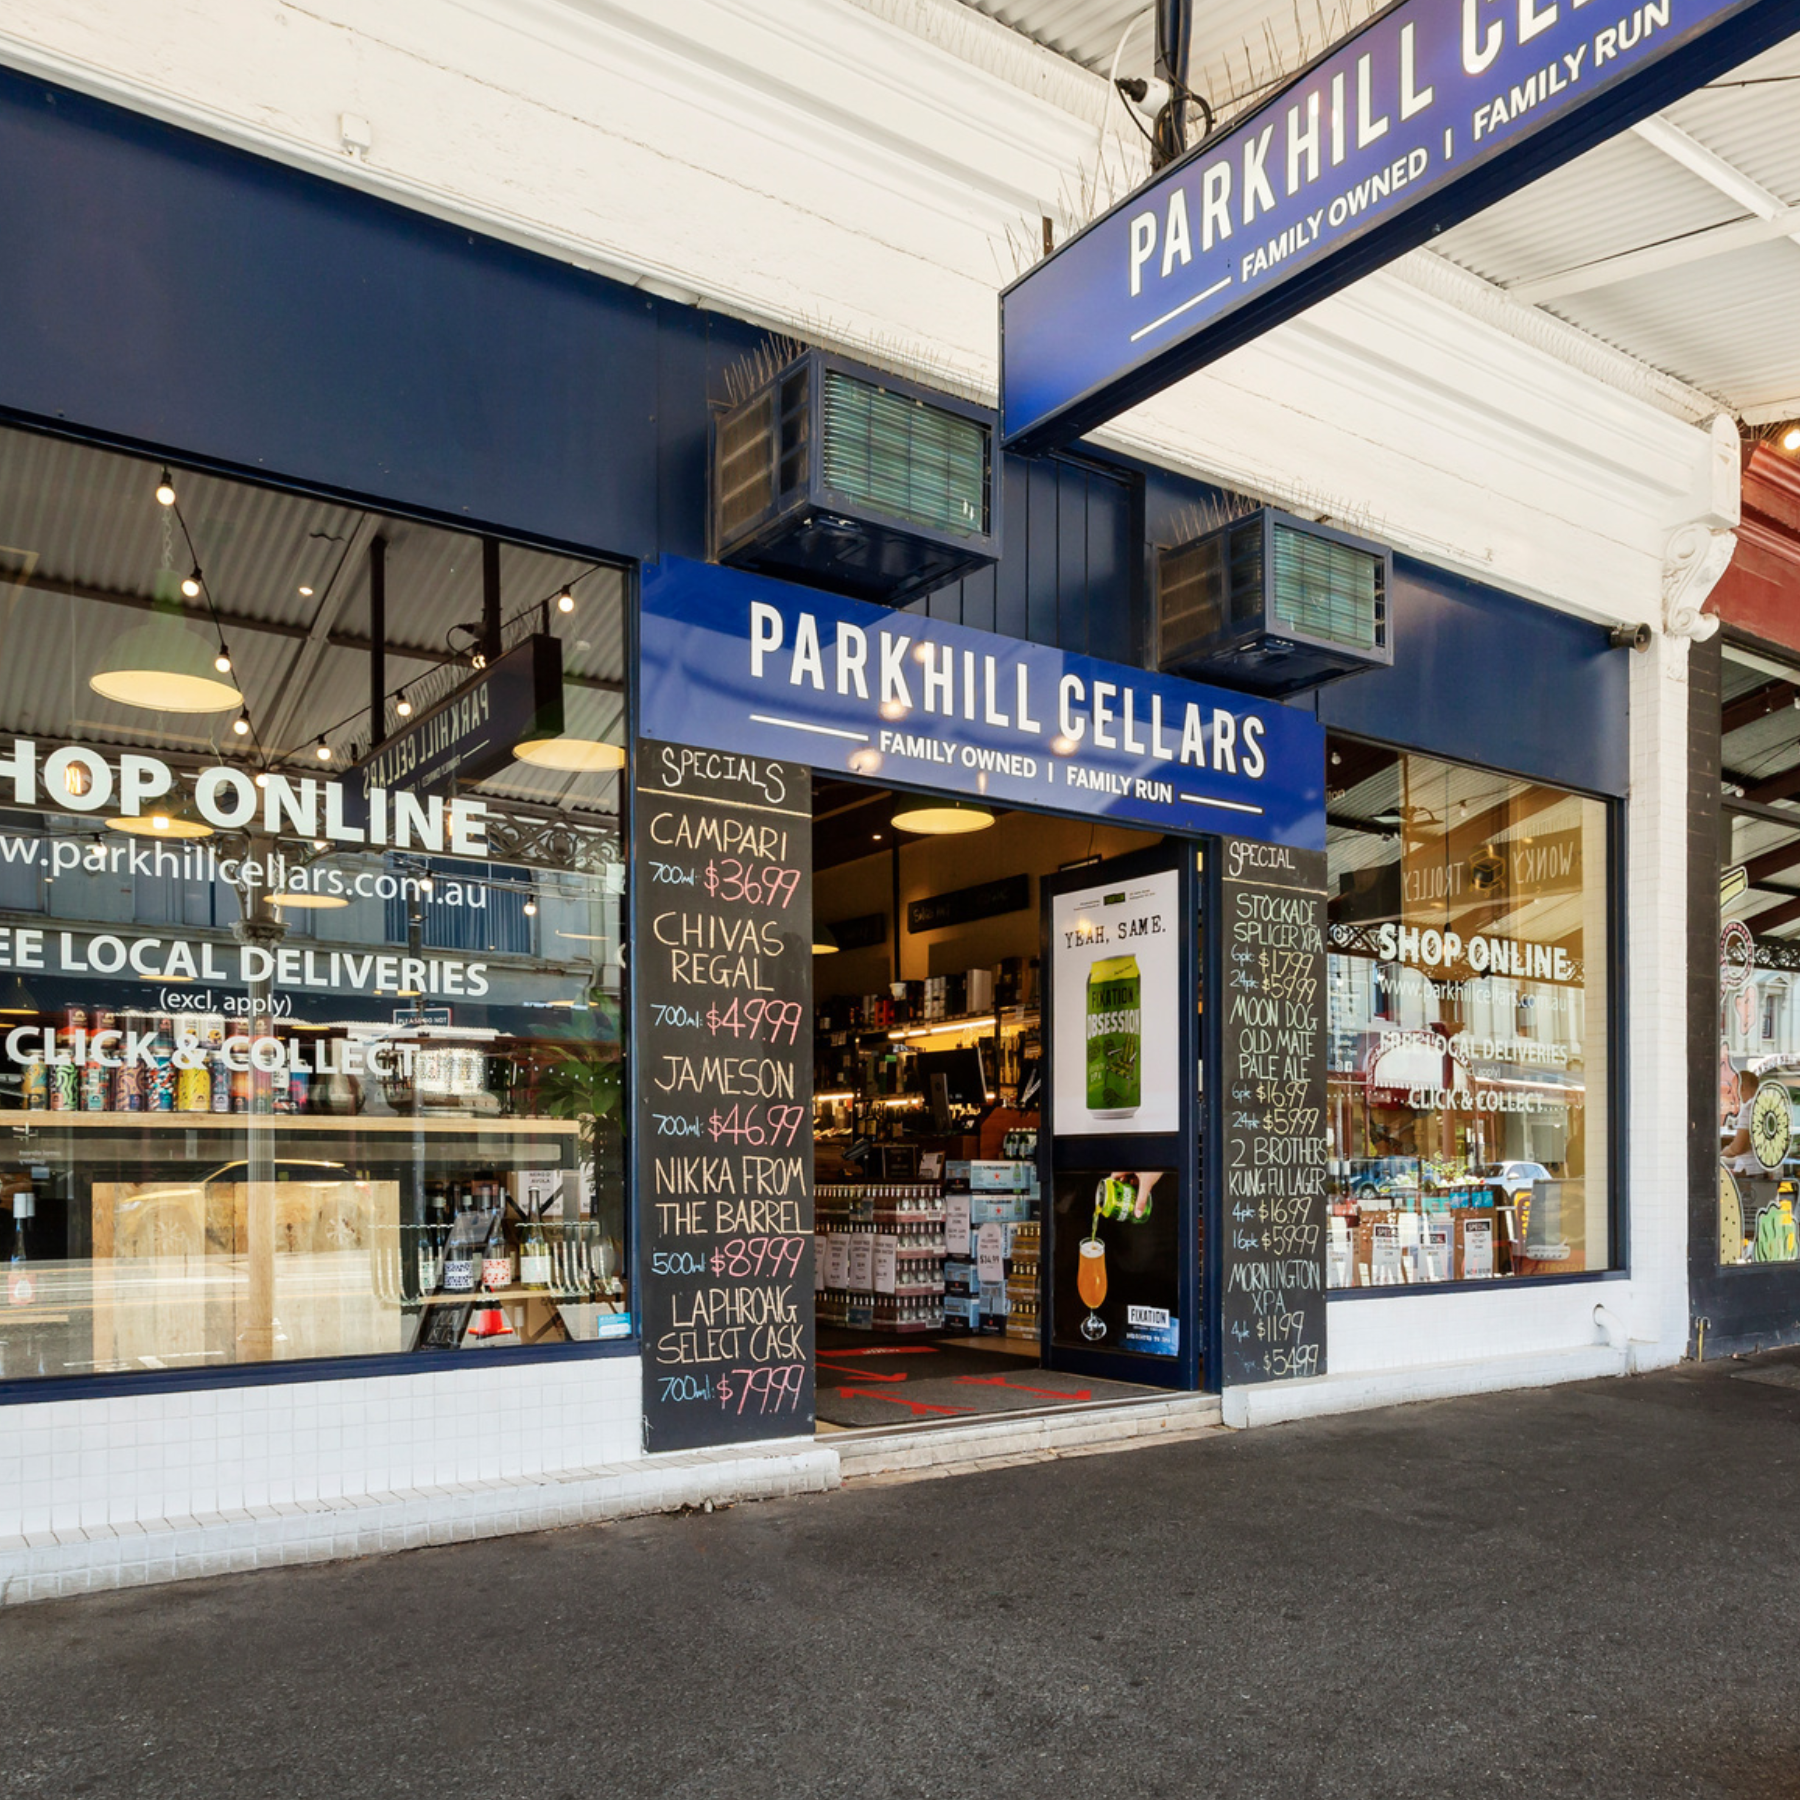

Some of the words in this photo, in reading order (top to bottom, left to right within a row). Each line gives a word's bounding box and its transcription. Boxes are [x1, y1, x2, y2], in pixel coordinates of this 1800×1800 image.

[1129, 18, 1434, 297] PARKHILL
[1240, 208, 1325, 283] FAMILY
[1329, 147, 1428, 228] OWNED
[1473, 44, 1587, 141] FAMILY
[1595, 0, 1669, 67] RUN
[749, 600, 1041, 735] PARKHILL
[1058, 674, 1266, 780] CELLARS
[661, 746, 786, 804] SPECIALS
[879, 730, 957, 762] FAMILY
[961, 746, 1037, 779] OWNED
[1066, 766, 1132, 795] FAMILY
[1133, 779, 1173, 804] RUN
[196, 767, 488, 857] ONLINE
[650, 812, 788, 862] CAMPARI
[1228, 840, 1296, 877] SPECIAL
[703, 858, 802, 910] $36.99
[1236, 892, 1318, 929] STOCKADE
[653, 910, 785, 957] CHIVAS
[1064, 925, 1110, 949] YEAH,
[1117, 914, 1166, 940] SAME.
[1233, 920, 1299, 950] SPLICER
[1301, 925, 1324, 955] XPA
[61, 931, 227, 982] LOCAL
[241, 944, 489, 998] DELIVERIES
[671, 949, 775, 992] REGAL
[1379, 922, 1462, 968] SHOP
[1468, 935, 1568, 981] ONLINE
[222, 992, 292, 1017] apply)
[1091, 986, 1134, 1009] FIXATION
[1229, 994, 1279, 1028] MOON
[1285, 1001, 1319, 1031] DOG
[705, 997, 803, 1046] $49.99
[6, 1026, 160, 1070] CLICK
[171, 1034, 208, 1070] &
[221, 1036, 421, 1077] COLLECT
[1239, 1028, 1272, 1054] OLD
[1275, 1029, 1316, 1058] MATE
[1426, 1032, 1480, 1059] LOCAL
[1483, 1038, 1568, 1064] DELIVERIES
[654, 1055, 794, 1100] JAMESON
[1238, 1053, 1279, 1081] PALE
[1283, 1056, 1312, 1083] ALE
[1409, 1088, 1458, 1110] CLICK
[1461, 1089, 1473, 1110] &
[1476, 1090, 1544, 1113] COLLECT
[707, 1102, 804, 1147] $46.99
[1262, 1107, 1320, 1136] $59.99
[1230, 1139, 1247, 1168] 2
[1253, 1136, 1328, 1166] BROTHERS
[655, 1156, 737, 1195] NIKKA
[742, 1156, 807, 1197] FROM
[1228, 1167, 1267, 1198] KUNG
[1267, 1167, 1285, 1197] FU
[1287, 1166, 1327, 1196] LAGER
[655, 1200, 708, 1236] THE
[715, 1198, 814, 1235] BARREL
[1258, 1196, 1313, 1224] $16.99
[709, 1236, 805, 1279] $89.99
[1261, 1224, 1320, 1256] $59.99
[1227, 1259, 1321, 1294] MORNINGTON
[1251, 1289, 1287, 1316] XPA
[655, 1326, 747, 1364] SELECT
[749, 1324, 807, 1362] CASK
[1255, 1310, 1305, 1345] $11.99
[716, 1364, 806, 1416] $79.99
